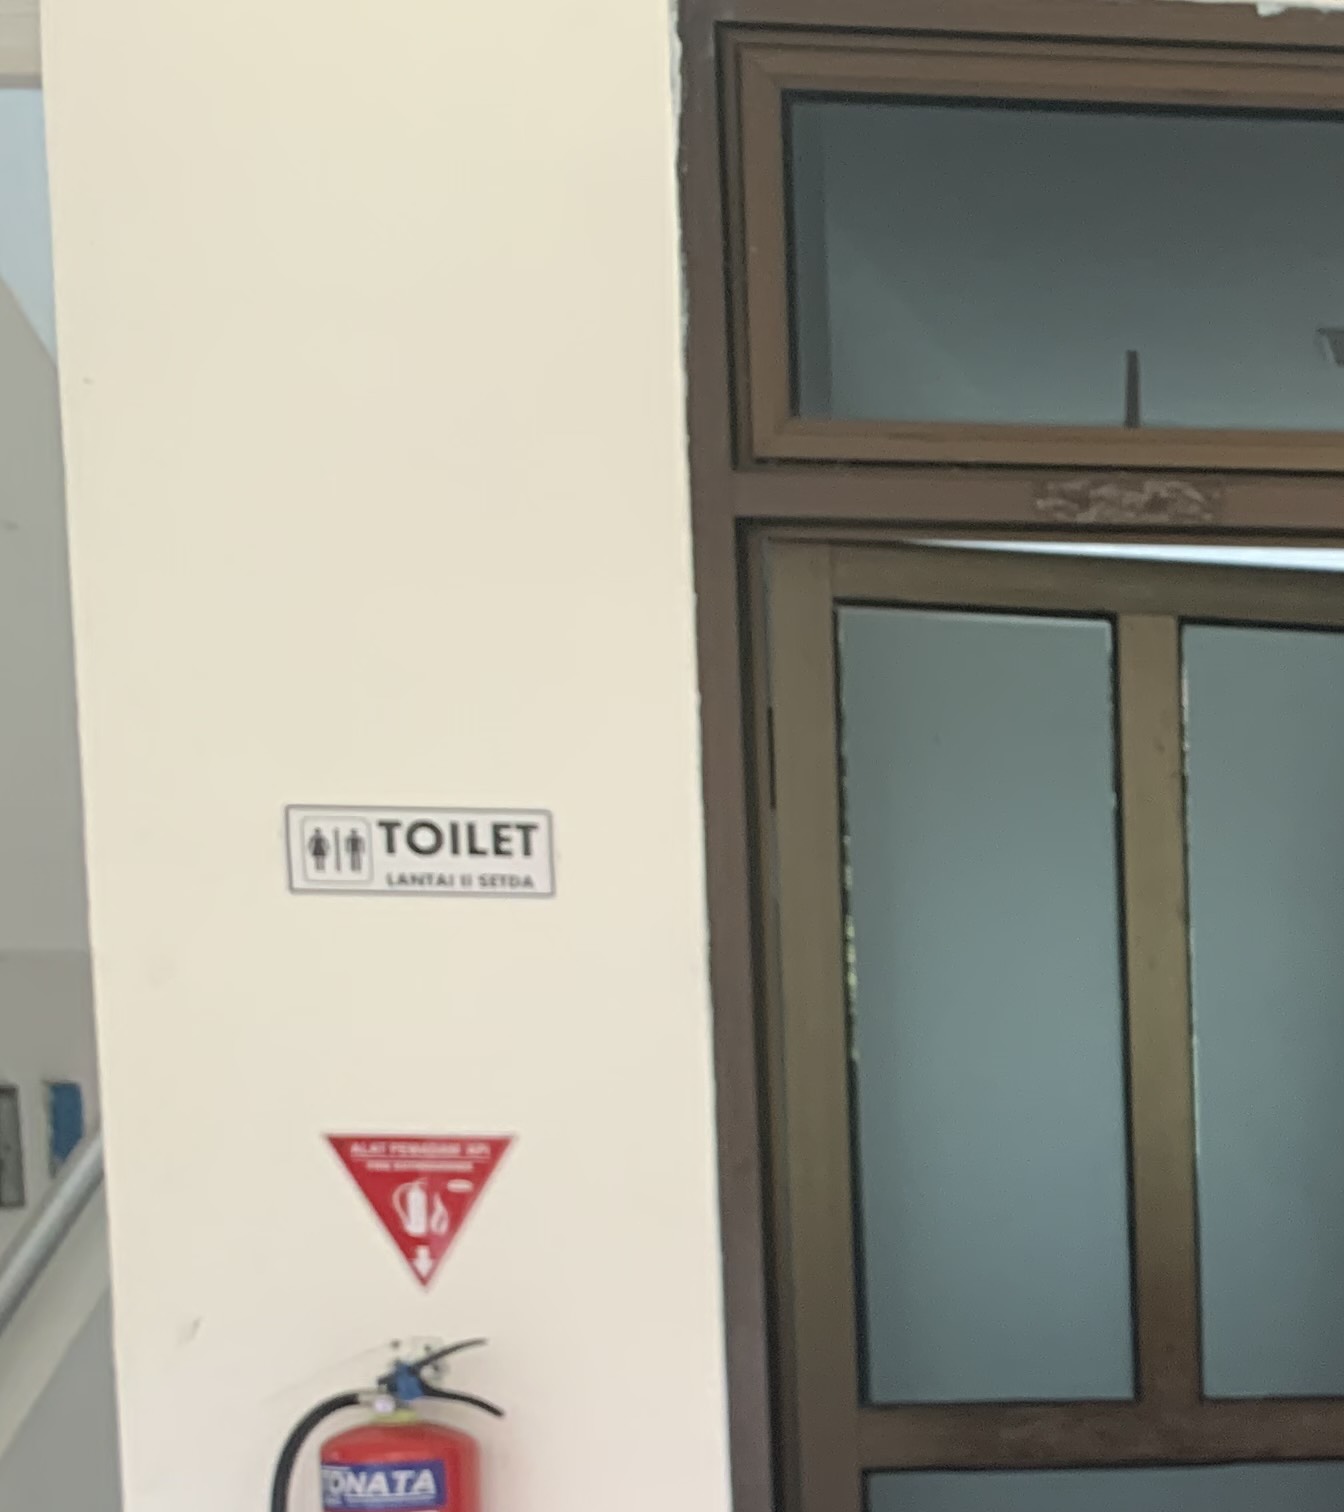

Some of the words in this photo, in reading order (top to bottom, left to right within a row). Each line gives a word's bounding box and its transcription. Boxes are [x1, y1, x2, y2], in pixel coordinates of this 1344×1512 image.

[377, 819, 539, 857] TOILET
[386, 872, 454, 888] LANTAI
[460, 873, 472, 888] II
[478, 872, 535, 889] SETDA
